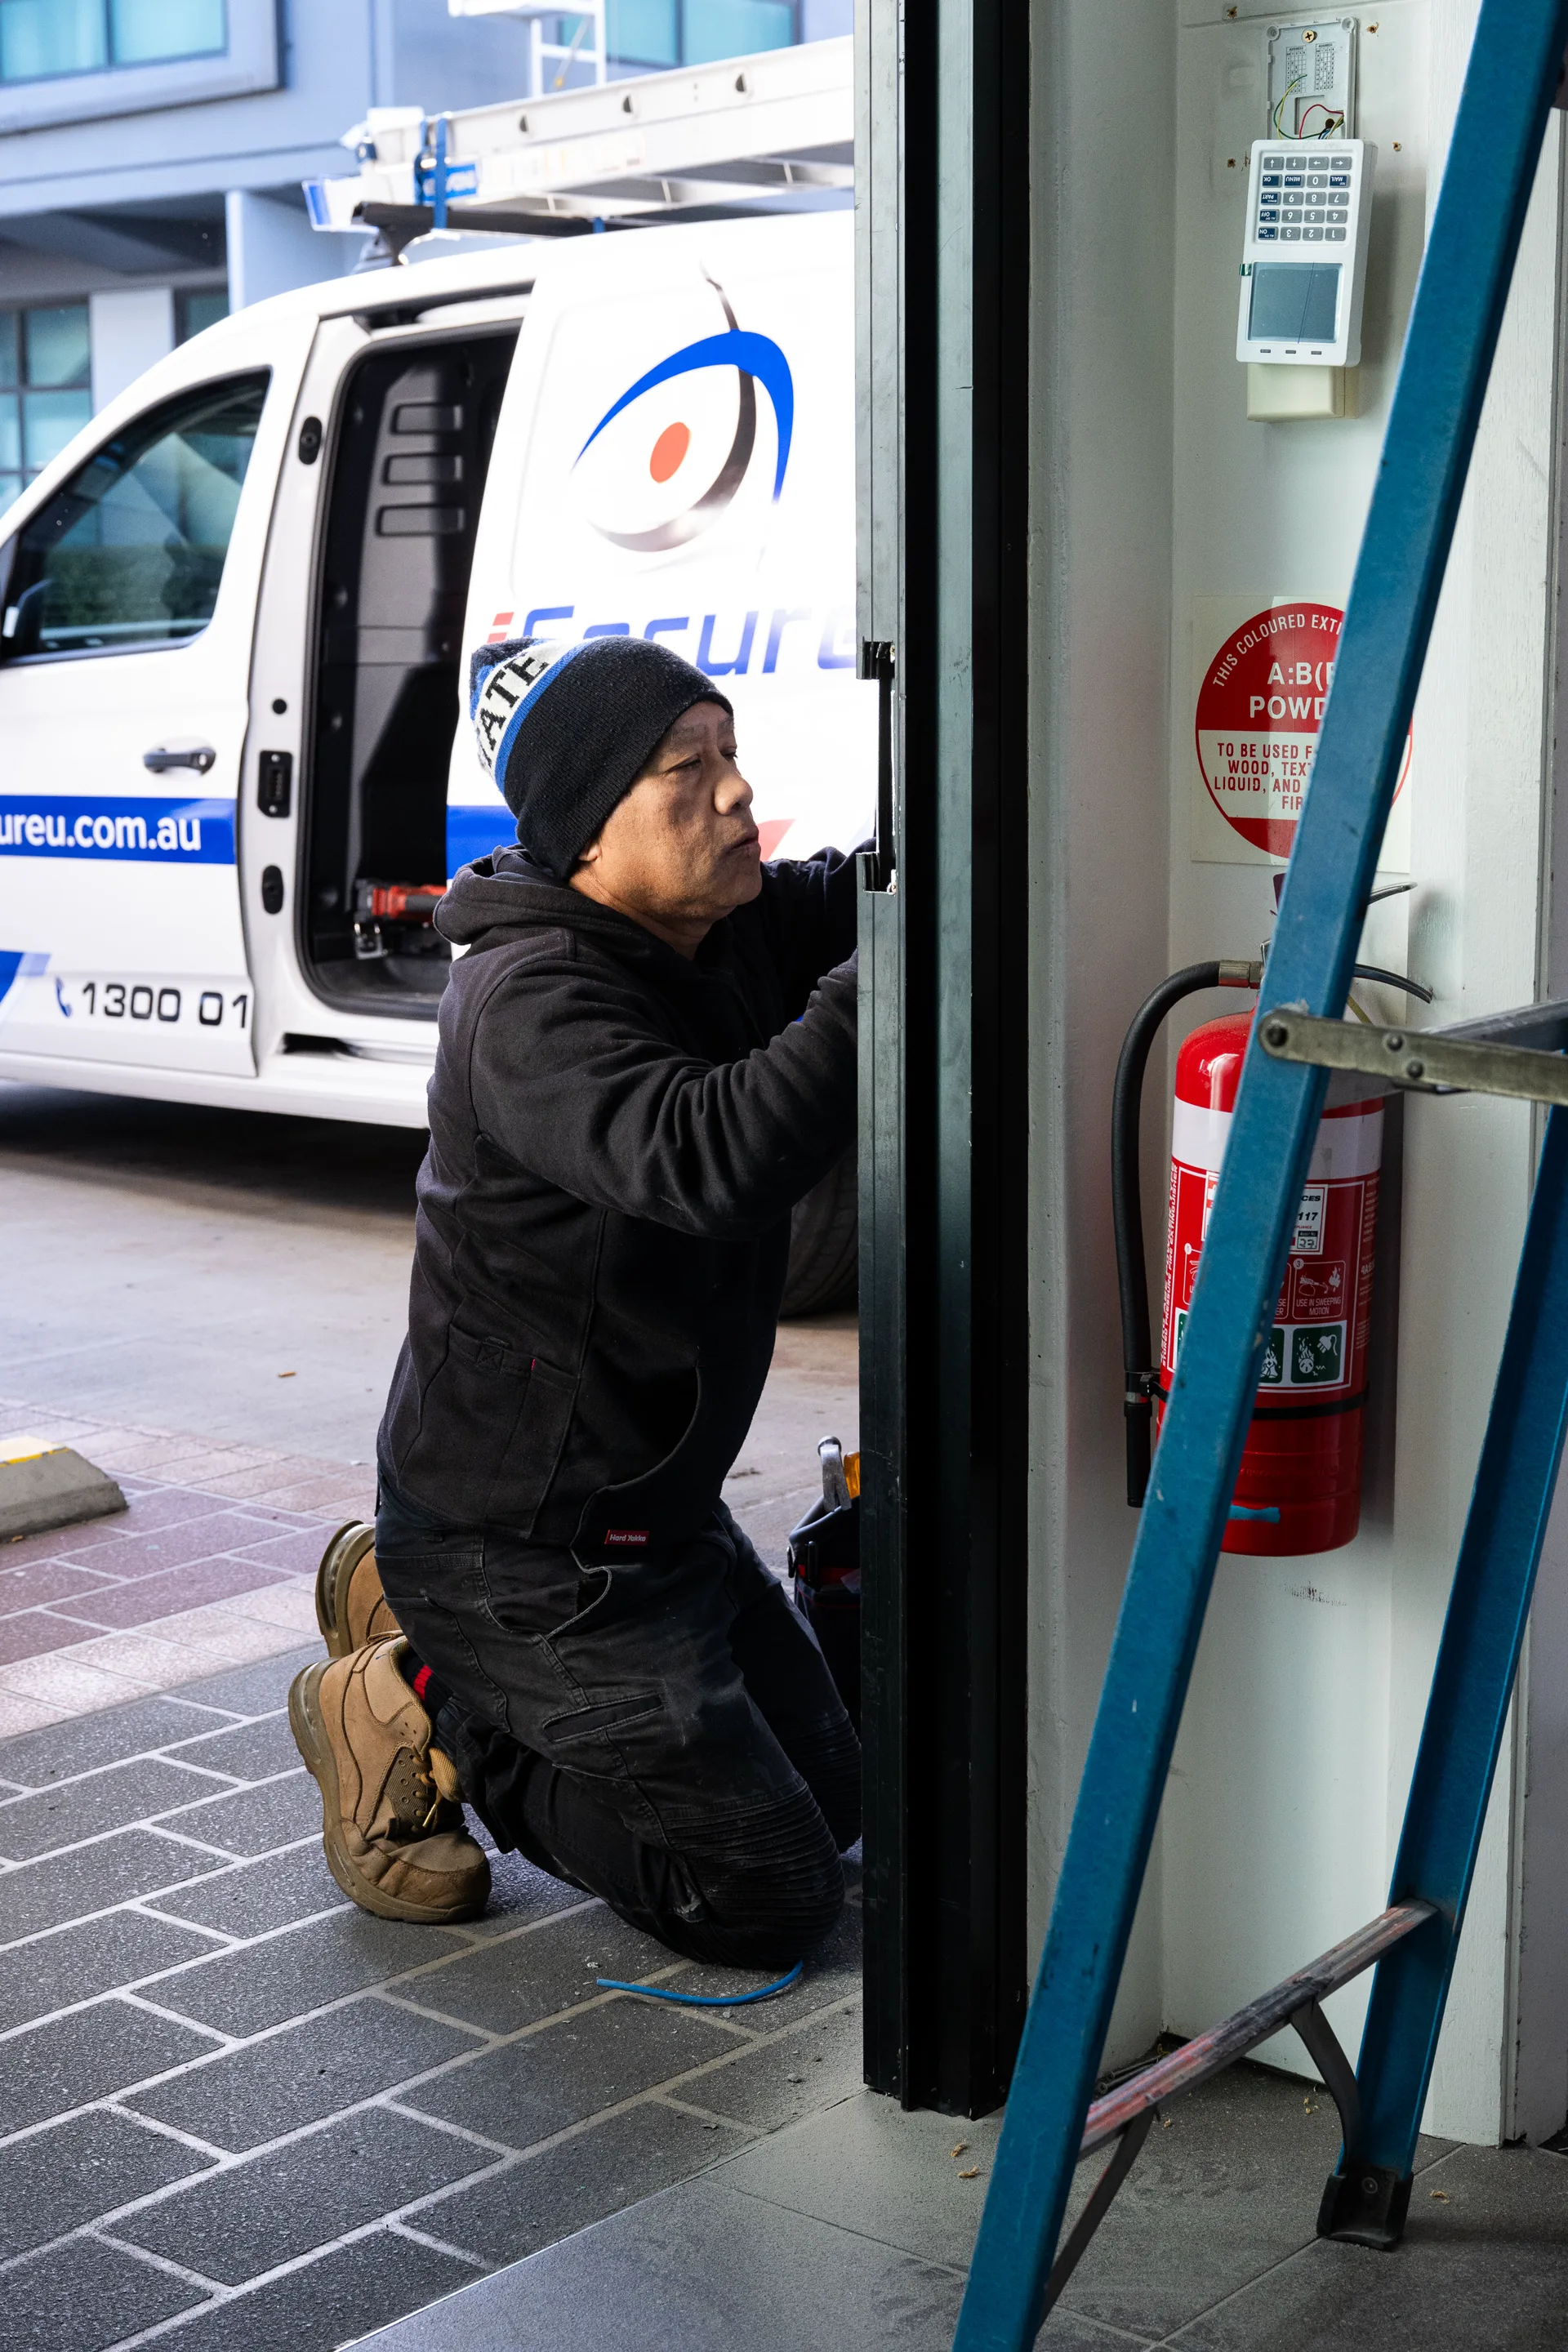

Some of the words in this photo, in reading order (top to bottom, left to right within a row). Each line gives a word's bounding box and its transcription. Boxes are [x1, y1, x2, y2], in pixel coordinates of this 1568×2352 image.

[1312, 176, 1319, 185] 0
[1289, 194, 1294, 203] 9
[1312, 194, 1317, 203] 8
[1334, 194, 1339, 203] 7
[1333, 212, 1339, 220] 4
[1286, 229, 1292, 238] 3
[1308, 229, 1314, 238] 2
[1332, 230, 1335, 238] 1
[1213, 653, 1238, 687] THIS
[1236, 613, 1306, 655] COLOURED
[1217, 742, 1234, 757] TO
[1241, 743, 1257, 758] BE
[1263, 744, 1299, 760] USED
[1228, 760, 1275, 777] WOOD,
[1214, 776, 1267, 794] LIQUID,
[1272, 779, 1301, 793] AND
[0, 814, 202, 851] ureu.com.au
[82, 982, 181, 1022] 1300
[199, 991, 248, 1029] 01
[1296, 1298, 1308, 1307] USE
[1316, 1296, 1342, 1306] SWEEPING
[1309, 1307, 1330, 1316] MOTION
